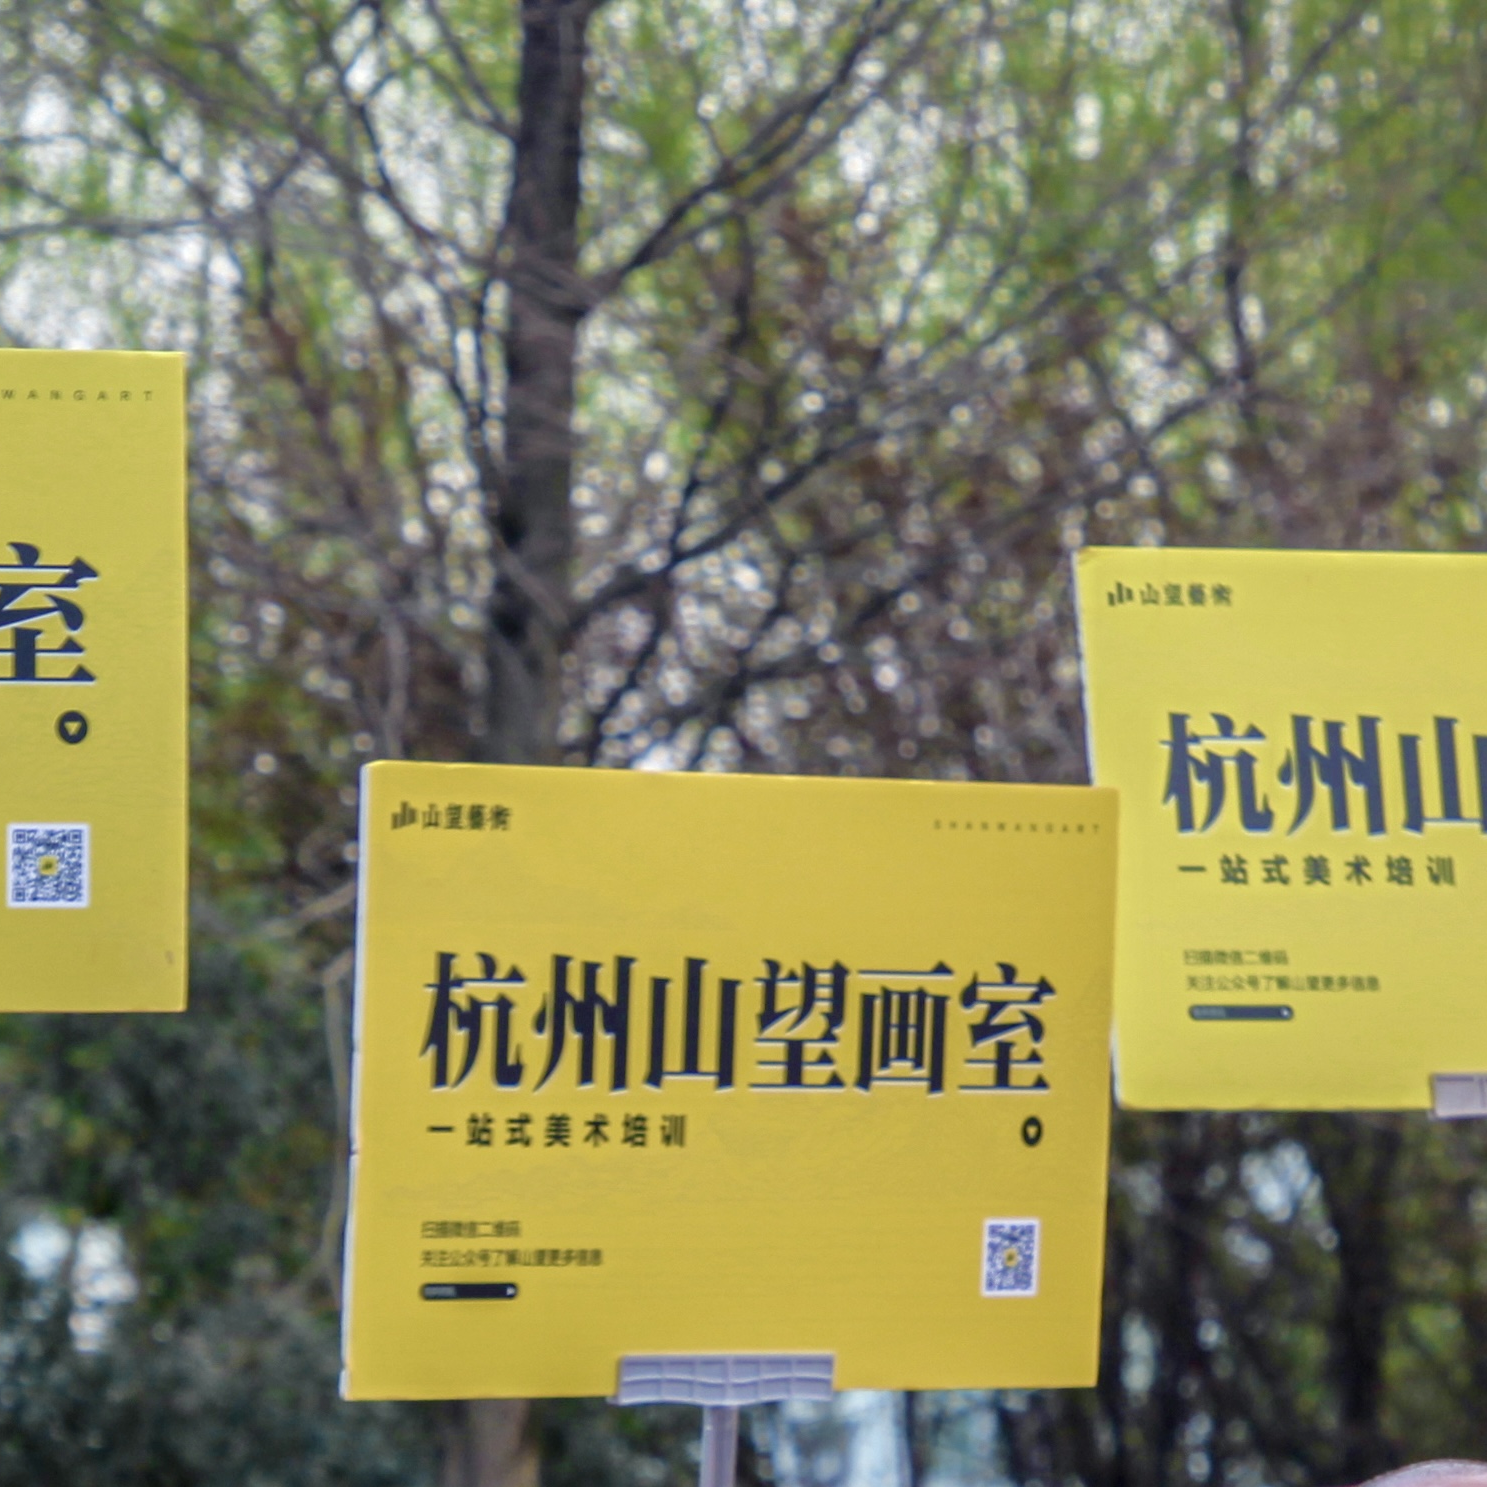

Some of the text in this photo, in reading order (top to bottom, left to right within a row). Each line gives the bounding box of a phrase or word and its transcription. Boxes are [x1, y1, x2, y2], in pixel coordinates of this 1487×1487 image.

[1178, 854, 1455, 886] 一站式美术培训
[420, 952, 1056, 1094] 杭州山望画室
[426, 1112, 686, 1148] 一站式美术培训
